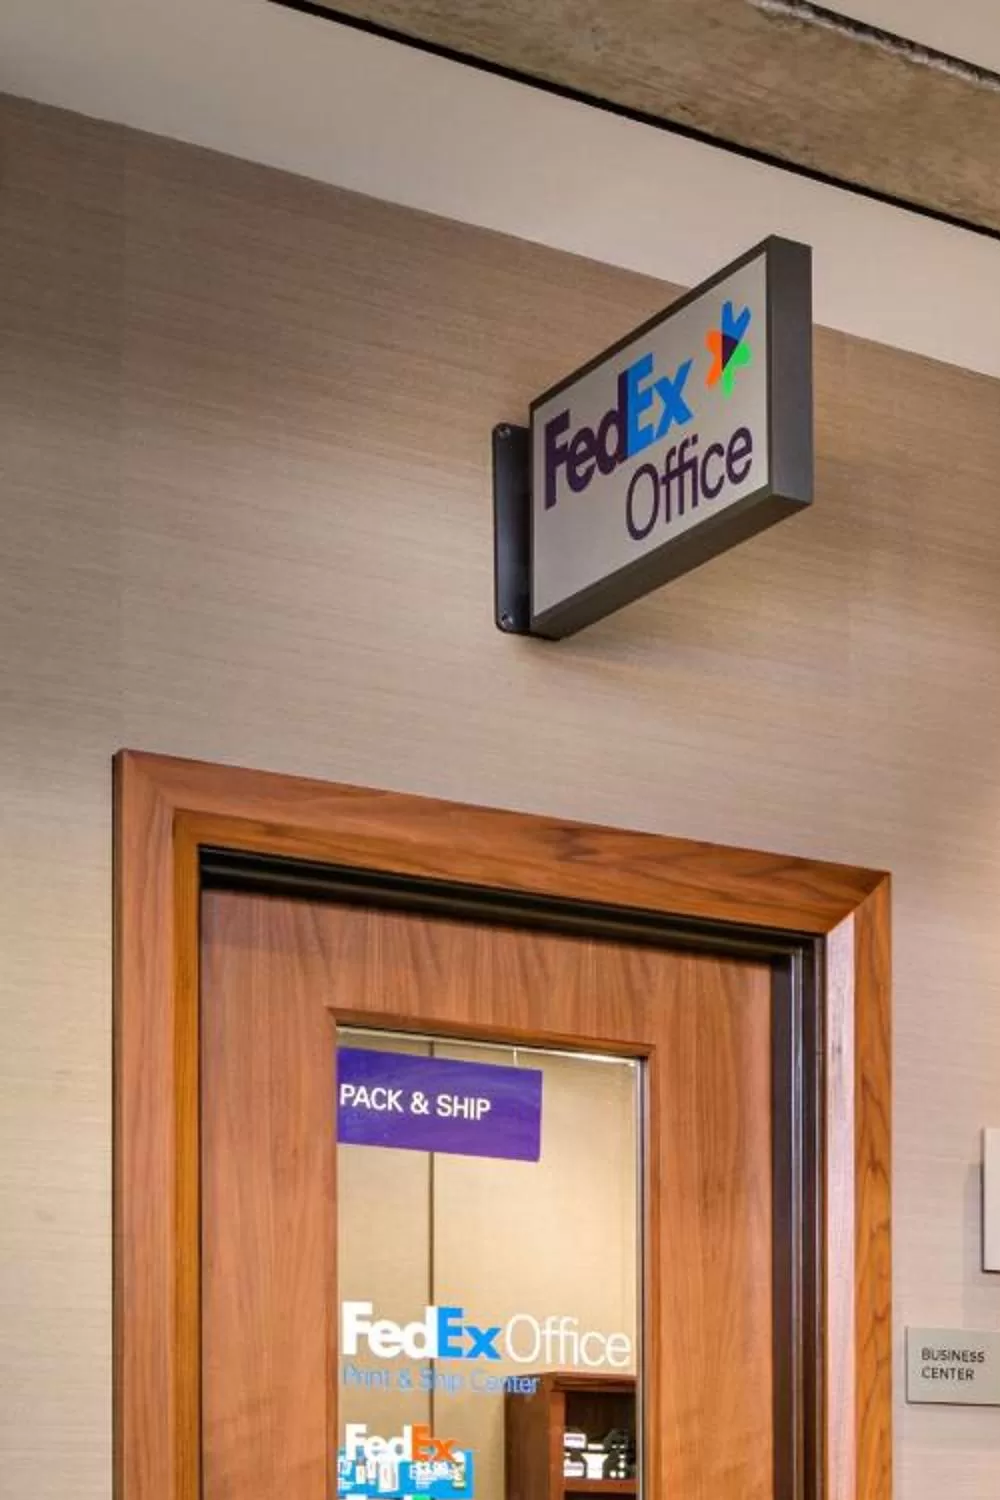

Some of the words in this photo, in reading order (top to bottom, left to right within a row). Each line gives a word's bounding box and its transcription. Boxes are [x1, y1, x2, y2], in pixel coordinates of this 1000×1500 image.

[544, 352, 694, 511] FedEx
[626, 427, 753, 541] Office
[339, 1084, 403, 1112] PACK
[410, 1091, 430, 1115] &
[436, 1096, 491, 1120] SHIP
[921, 1347, 985, 1363] BUSINESS
[470, 1371, 539, 1393] Center
[921, 1366, 975, 1381] CENTER
[345, 1423, 456, 1462] FedEx
